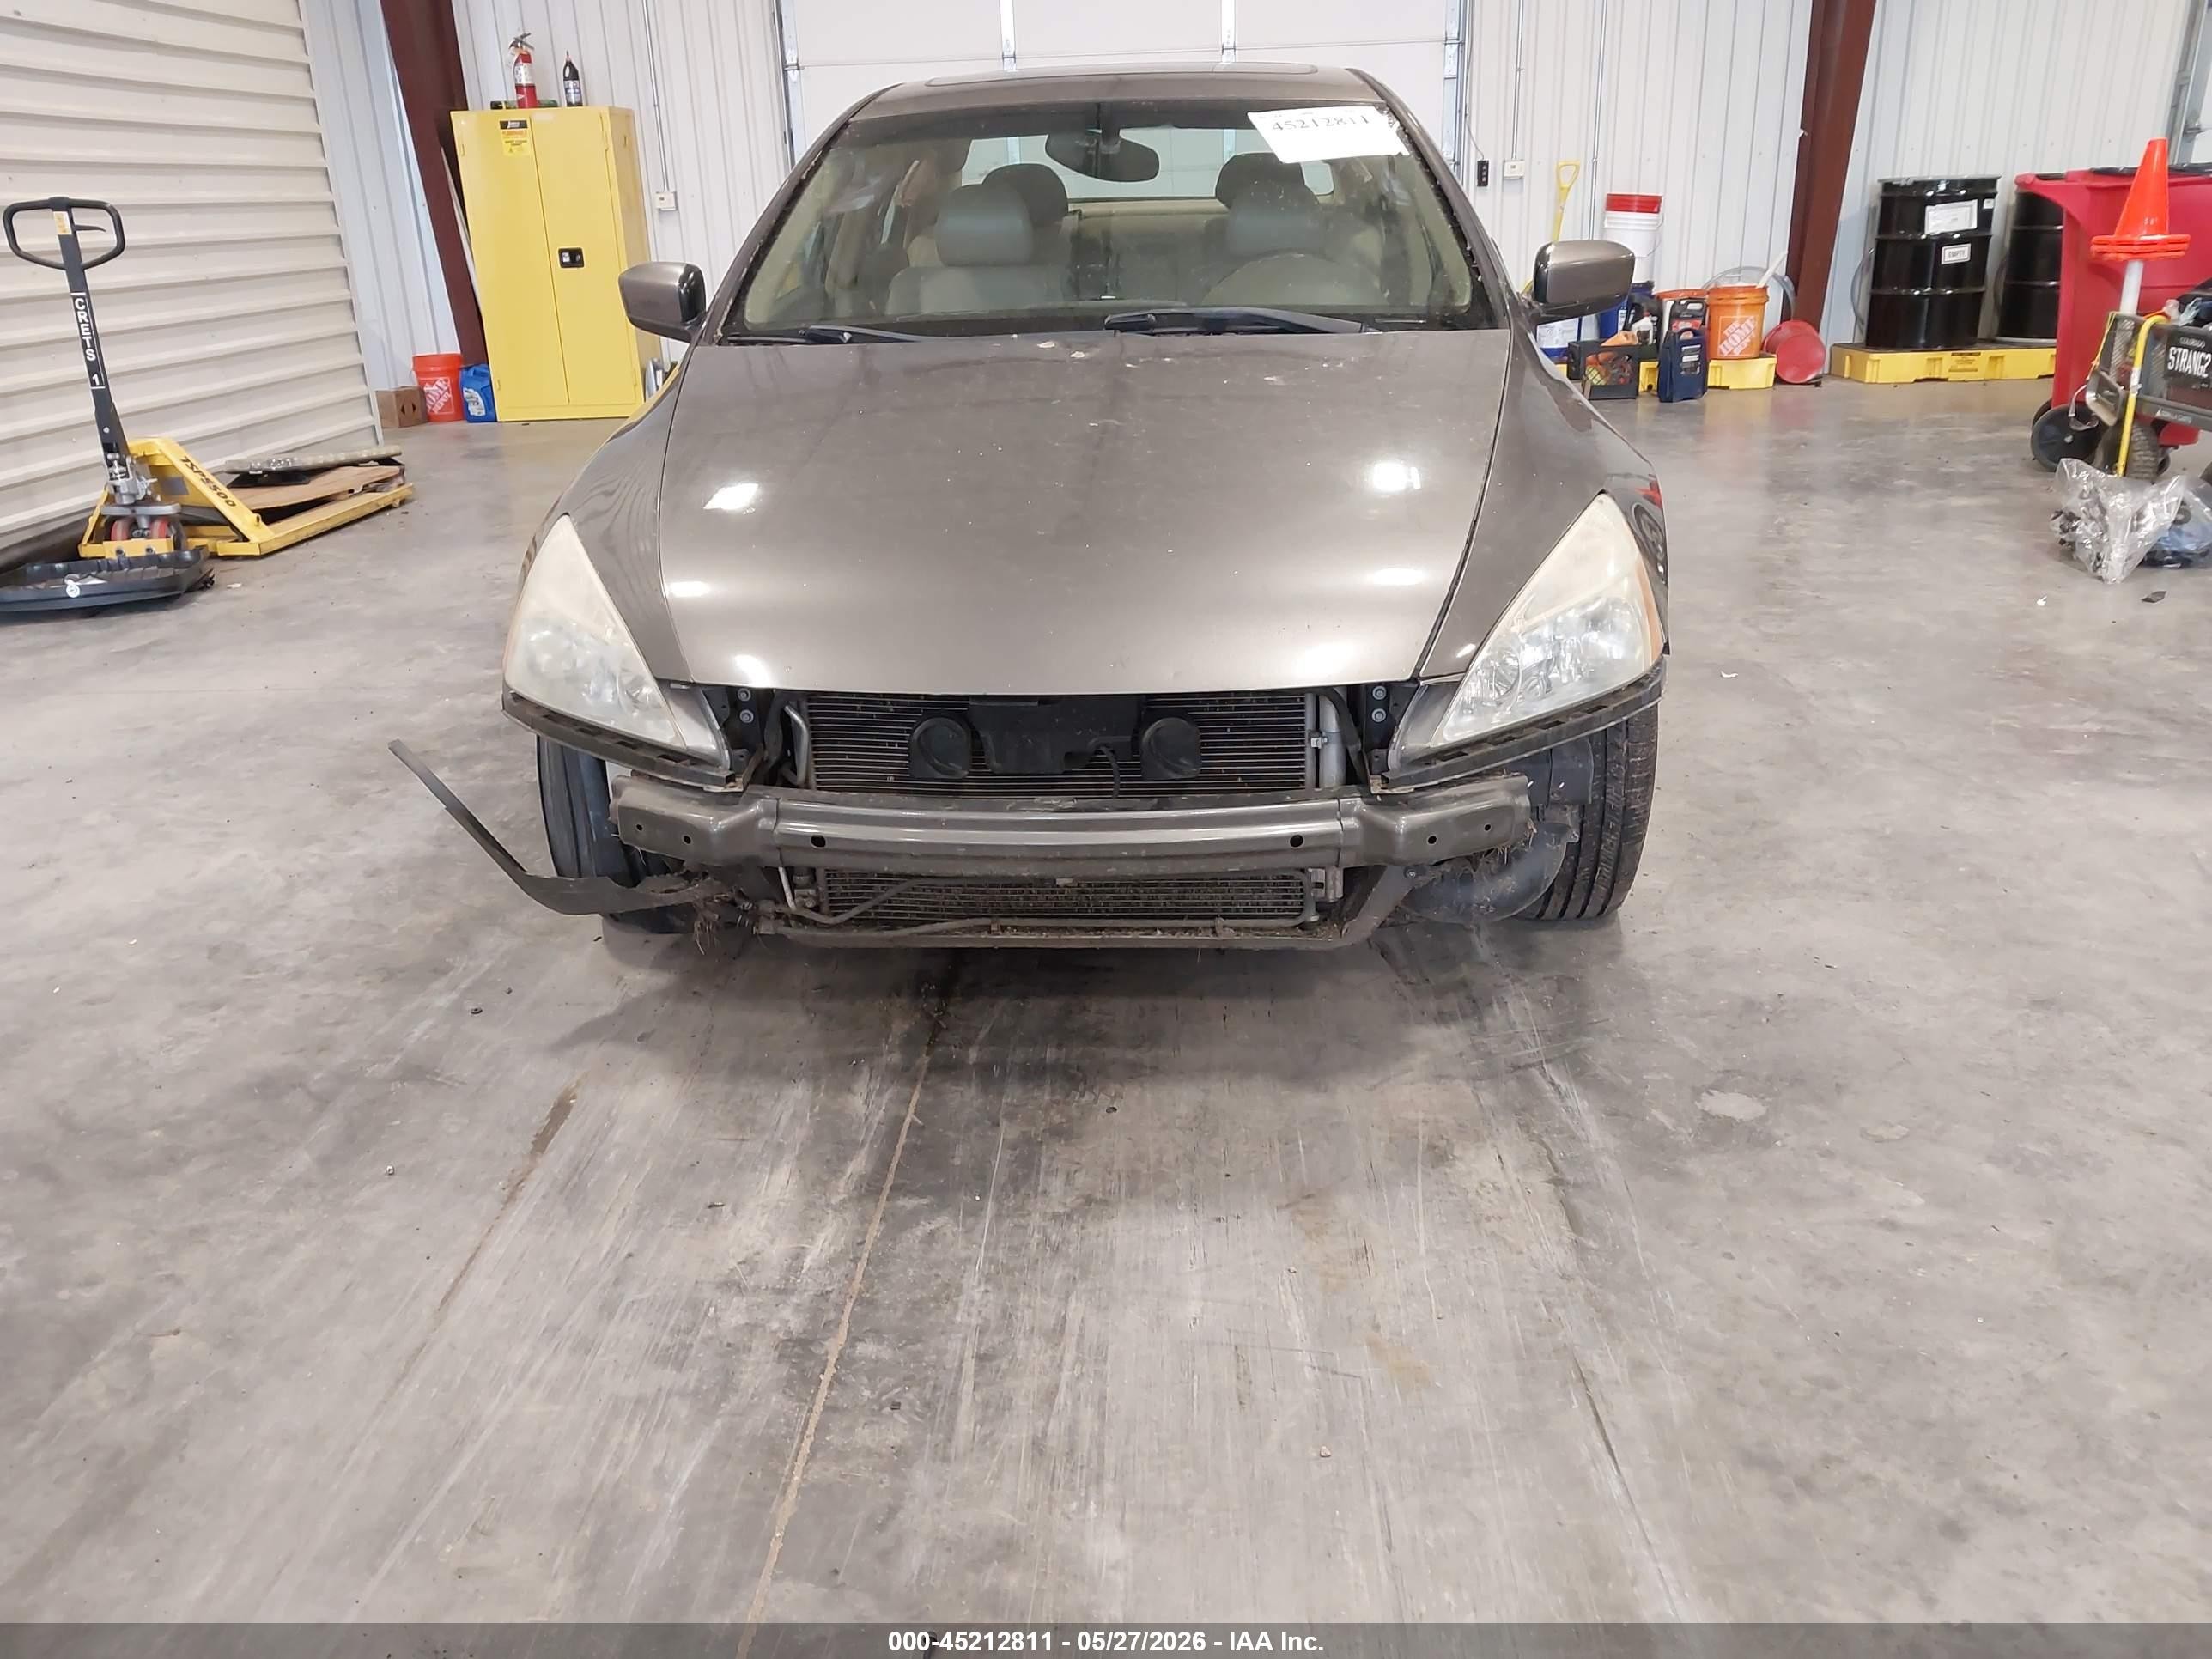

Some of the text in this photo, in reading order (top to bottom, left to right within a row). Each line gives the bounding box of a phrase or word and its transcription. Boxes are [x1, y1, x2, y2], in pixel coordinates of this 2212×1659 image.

[1273, 115, 1370, 131] 45212811
[74, 297, 100, 386] CRETS 1
[1717, 316, 1756, 356] HOME
[2167, 346, 2212, 378] STRANG2
